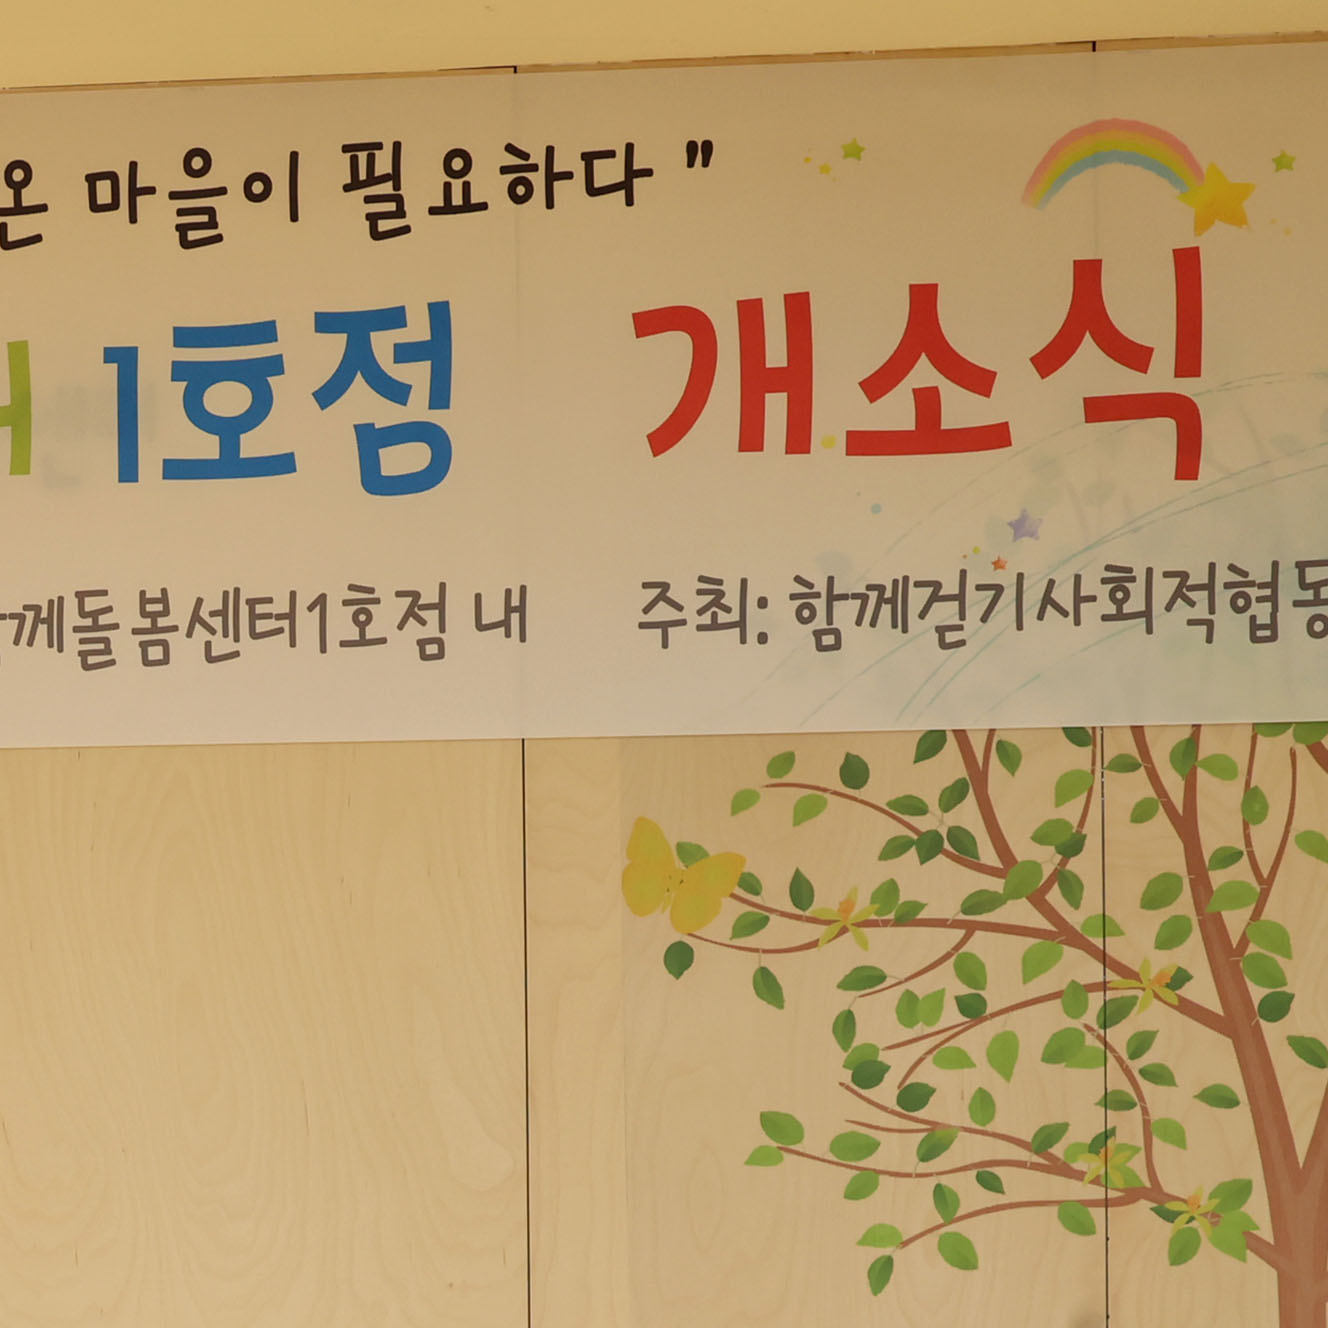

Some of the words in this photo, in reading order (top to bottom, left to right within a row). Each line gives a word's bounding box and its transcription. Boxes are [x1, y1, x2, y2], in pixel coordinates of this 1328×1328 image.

[83, 146, 301, 251] 마을이
[340, 139, 655, 243] 필요하다
[101, 299, 454, 498] 1호점
[631, 245, 1204, 482] 개소식
[472, 582, 529, 645] 내
